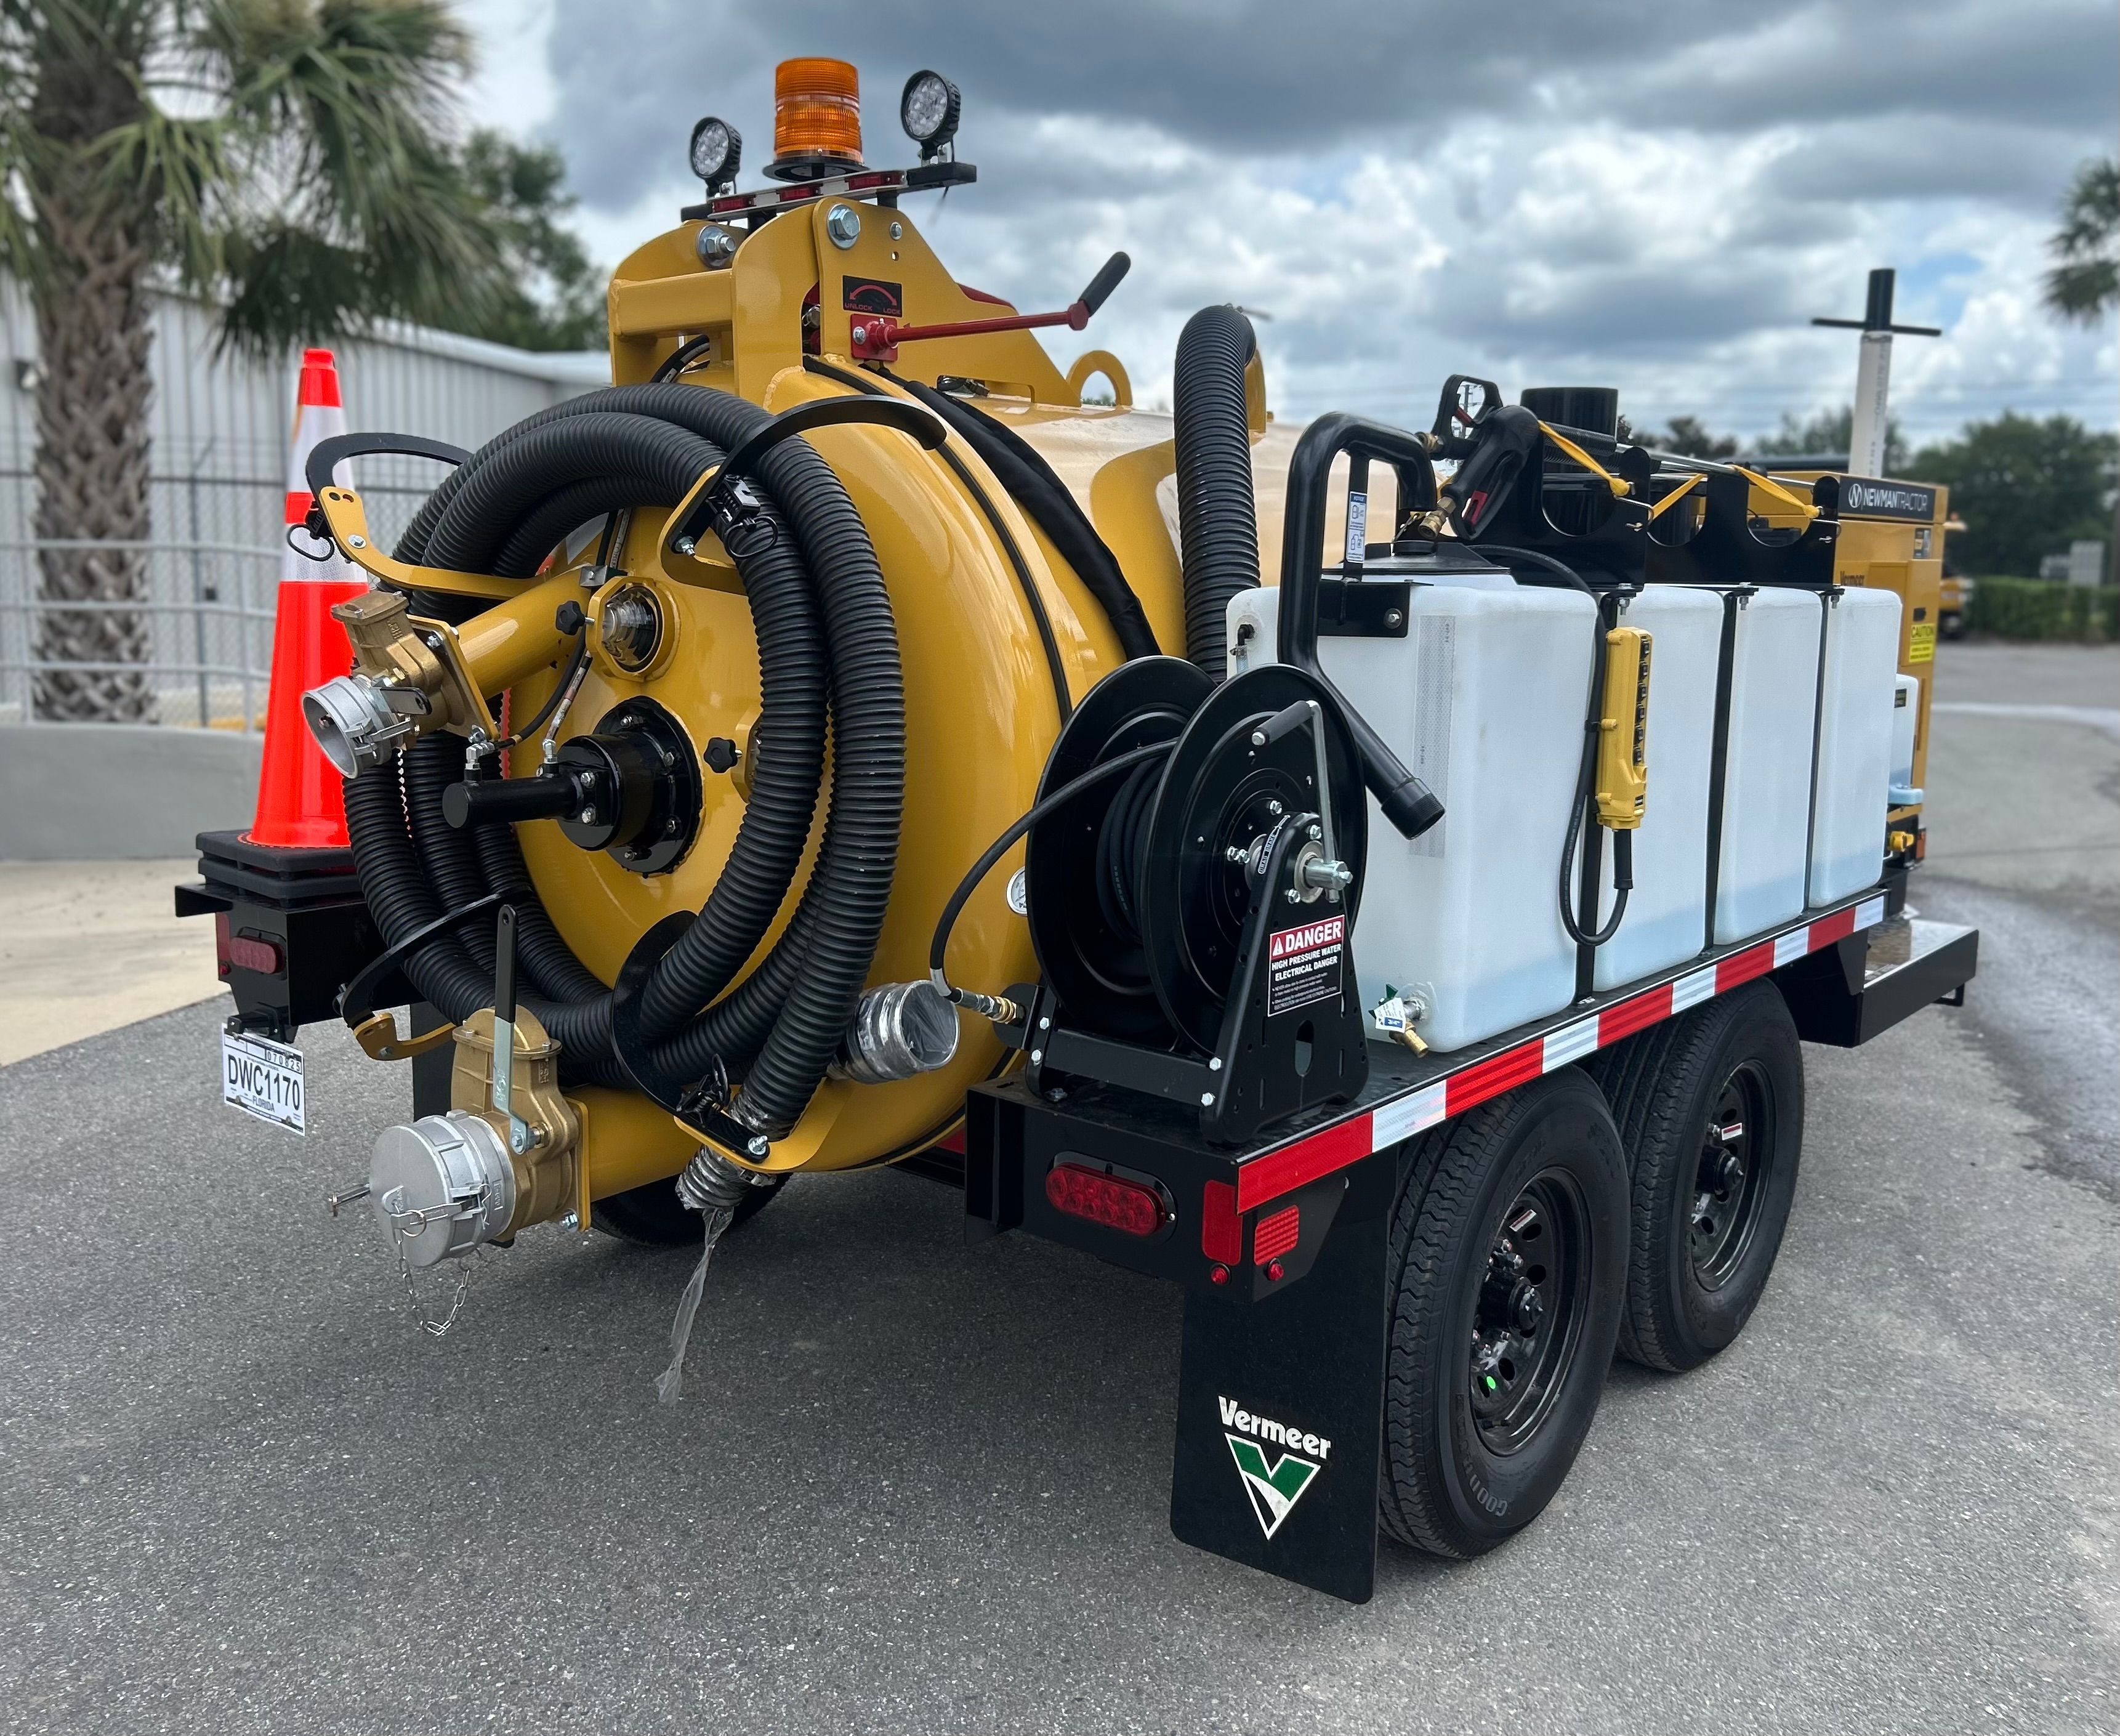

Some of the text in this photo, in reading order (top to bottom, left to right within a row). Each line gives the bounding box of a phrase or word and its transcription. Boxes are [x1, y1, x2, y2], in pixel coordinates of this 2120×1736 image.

[845, 302, 873, 311] UNLOCK
[883, 307, 901, 315] LOCK
[1840, 571, 1865, 587] Vermeer
[1285, 921, 1342, 953] DANGER
[1272, 943, 1342, 971] HIGH PRESSURE WATER
[1275, 964, 1313, 982] ELECTRICAL
[1313, 955, 1338, 970] DANGER
[228, 1054, 300, 1111] DWC1170
[252, 1095, 275, 1113] FLORIDA
[1218, 1395, 1331, 1459] Vermeer
